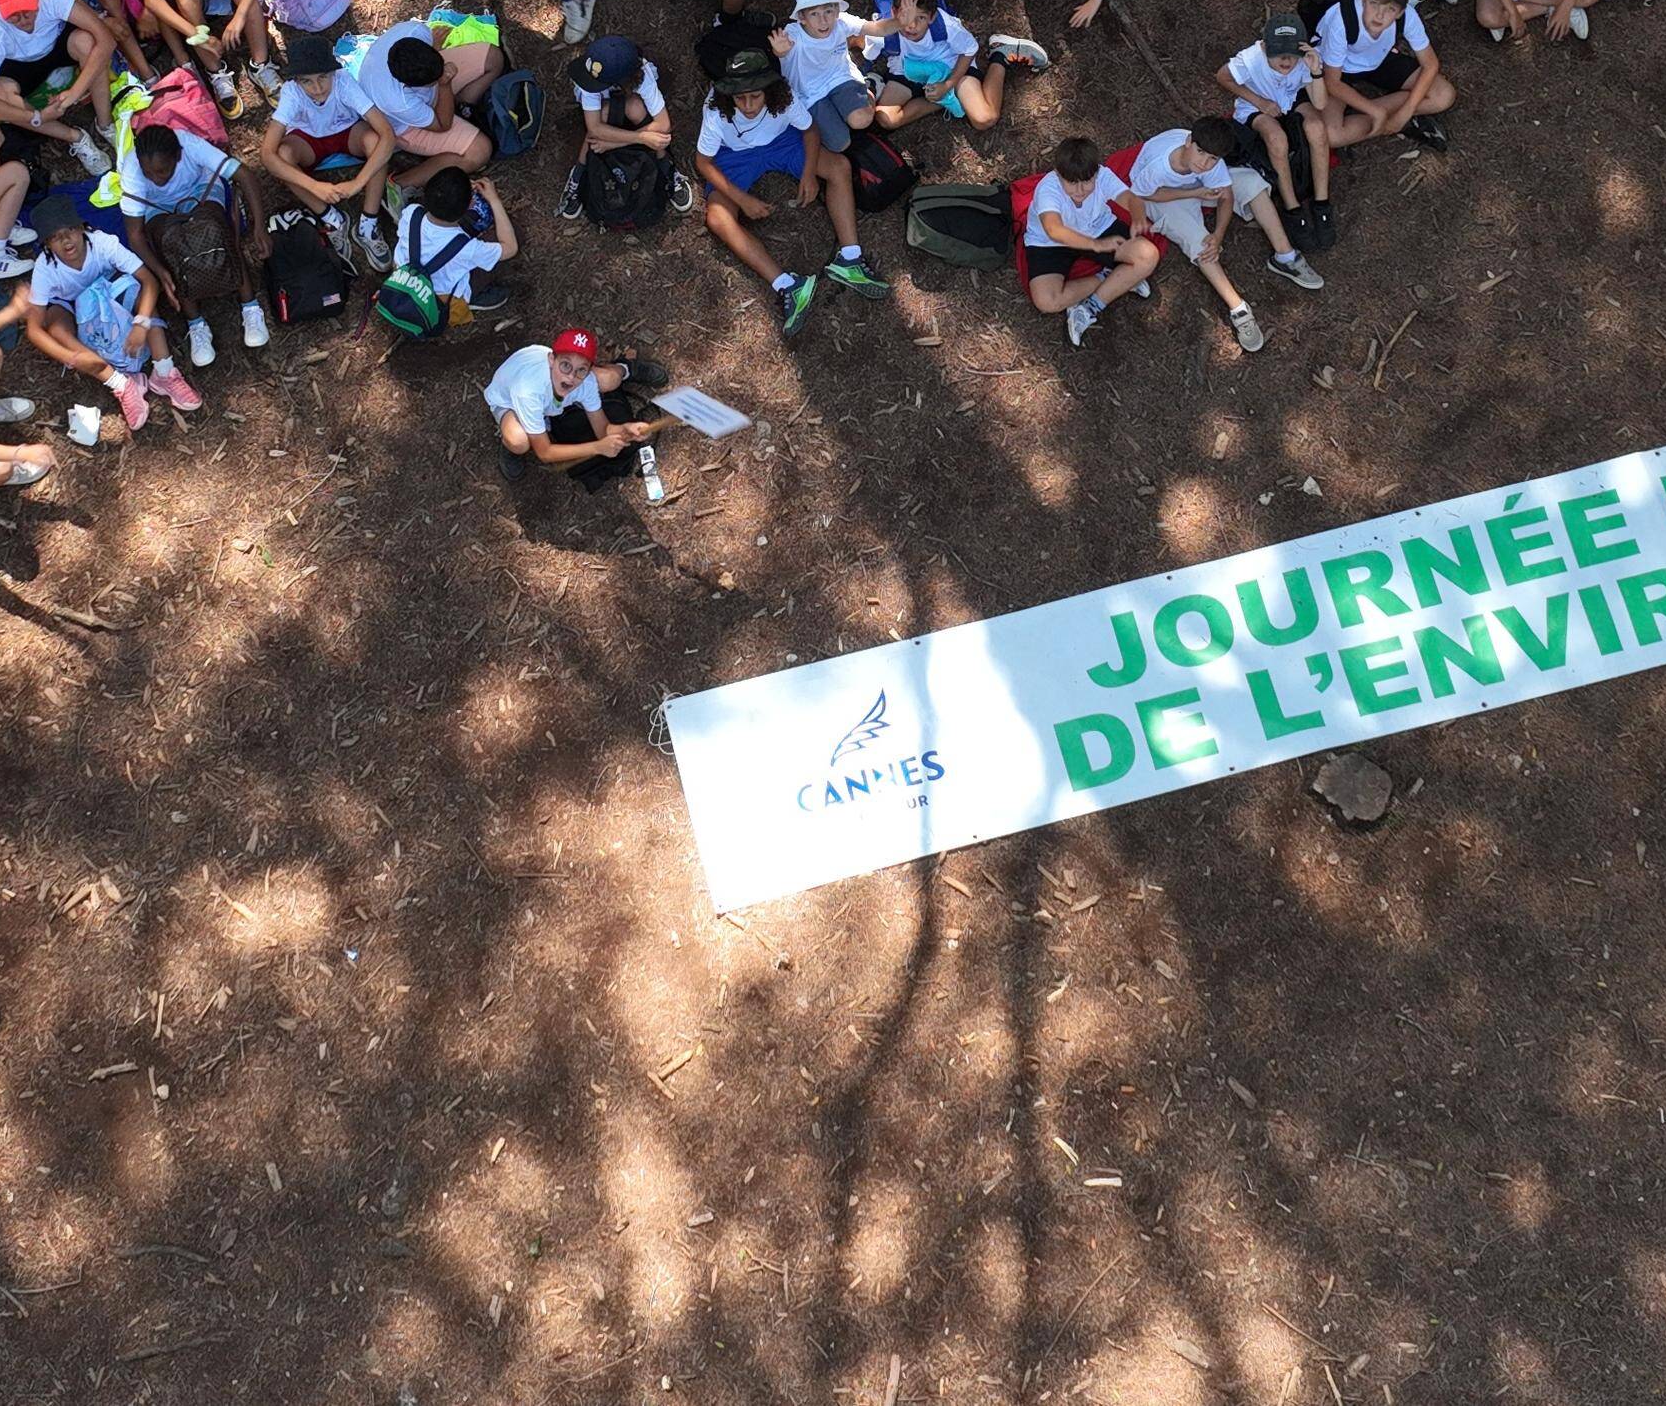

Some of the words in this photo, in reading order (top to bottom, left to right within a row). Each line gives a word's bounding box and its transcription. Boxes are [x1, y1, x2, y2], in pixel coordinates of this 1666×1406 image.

[572, 332, 589, 348] NY
[1086, 488, 1641, 690] JOURNÉE
[1053, 686, 1220, 792] DE
